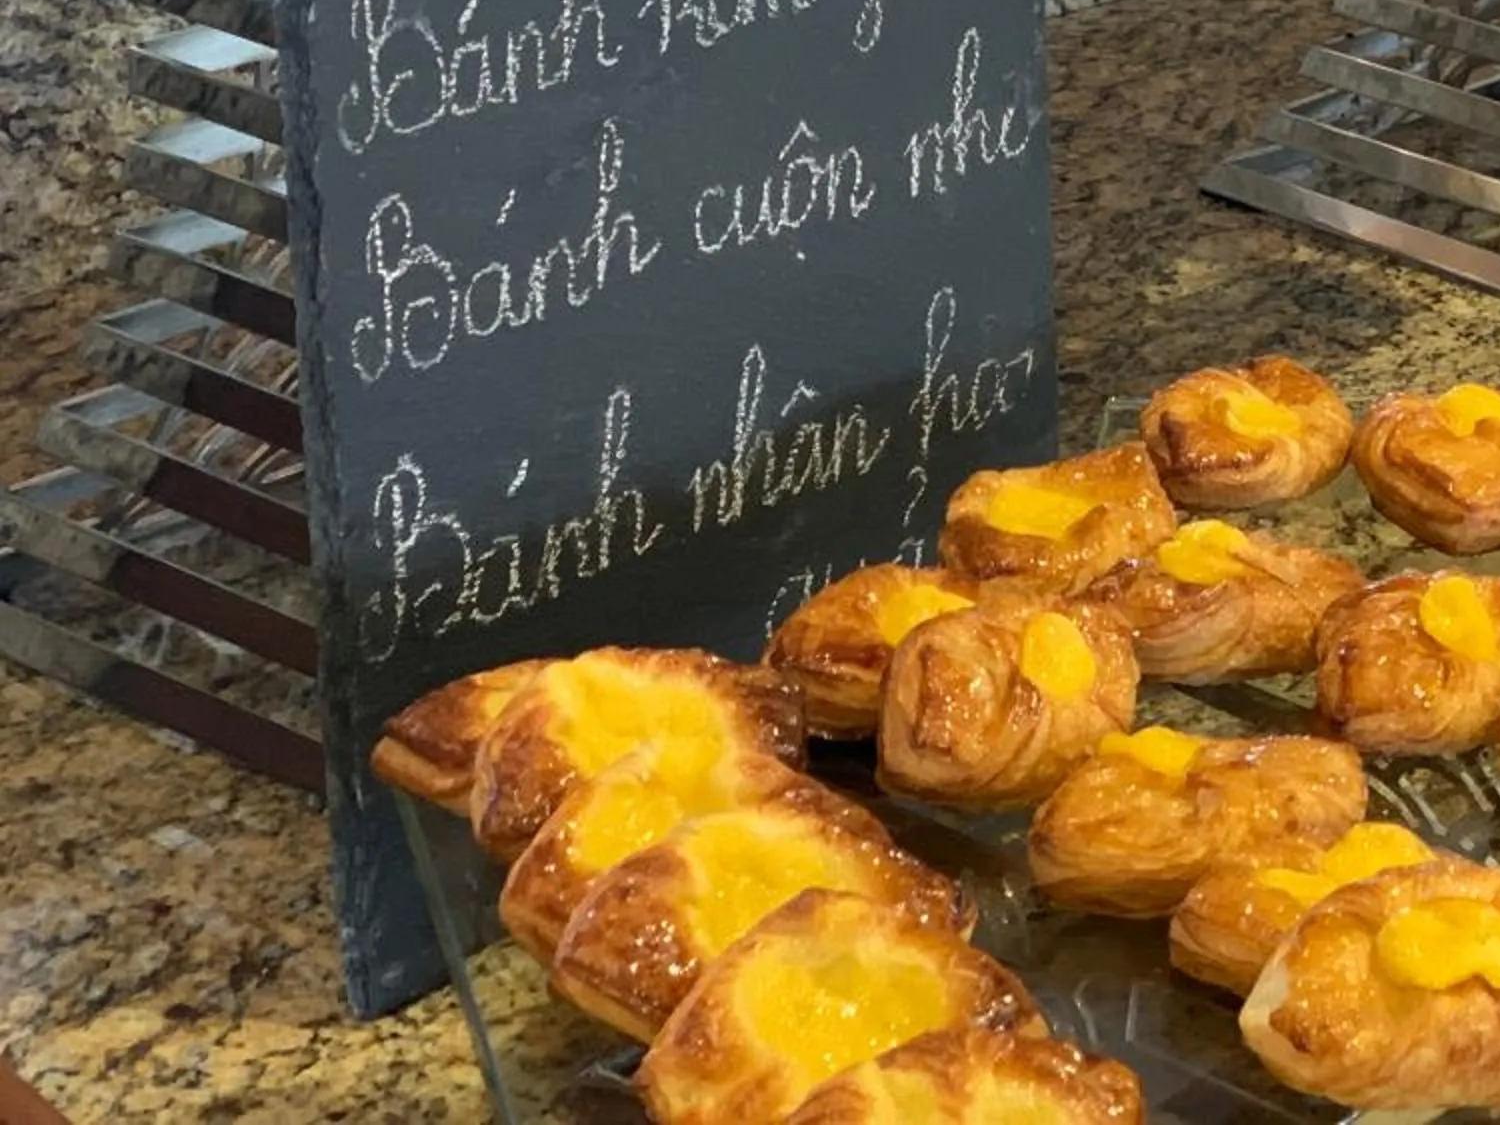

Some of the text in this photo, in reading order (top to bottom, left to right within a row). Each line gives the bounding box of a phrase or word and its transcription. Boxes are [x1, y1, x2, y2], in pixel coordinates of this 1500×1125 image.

[350, 116, 661, 382] Bánh
[358, 385, 663, 664] Bánh
[686, 343, 891, 534] nhân
